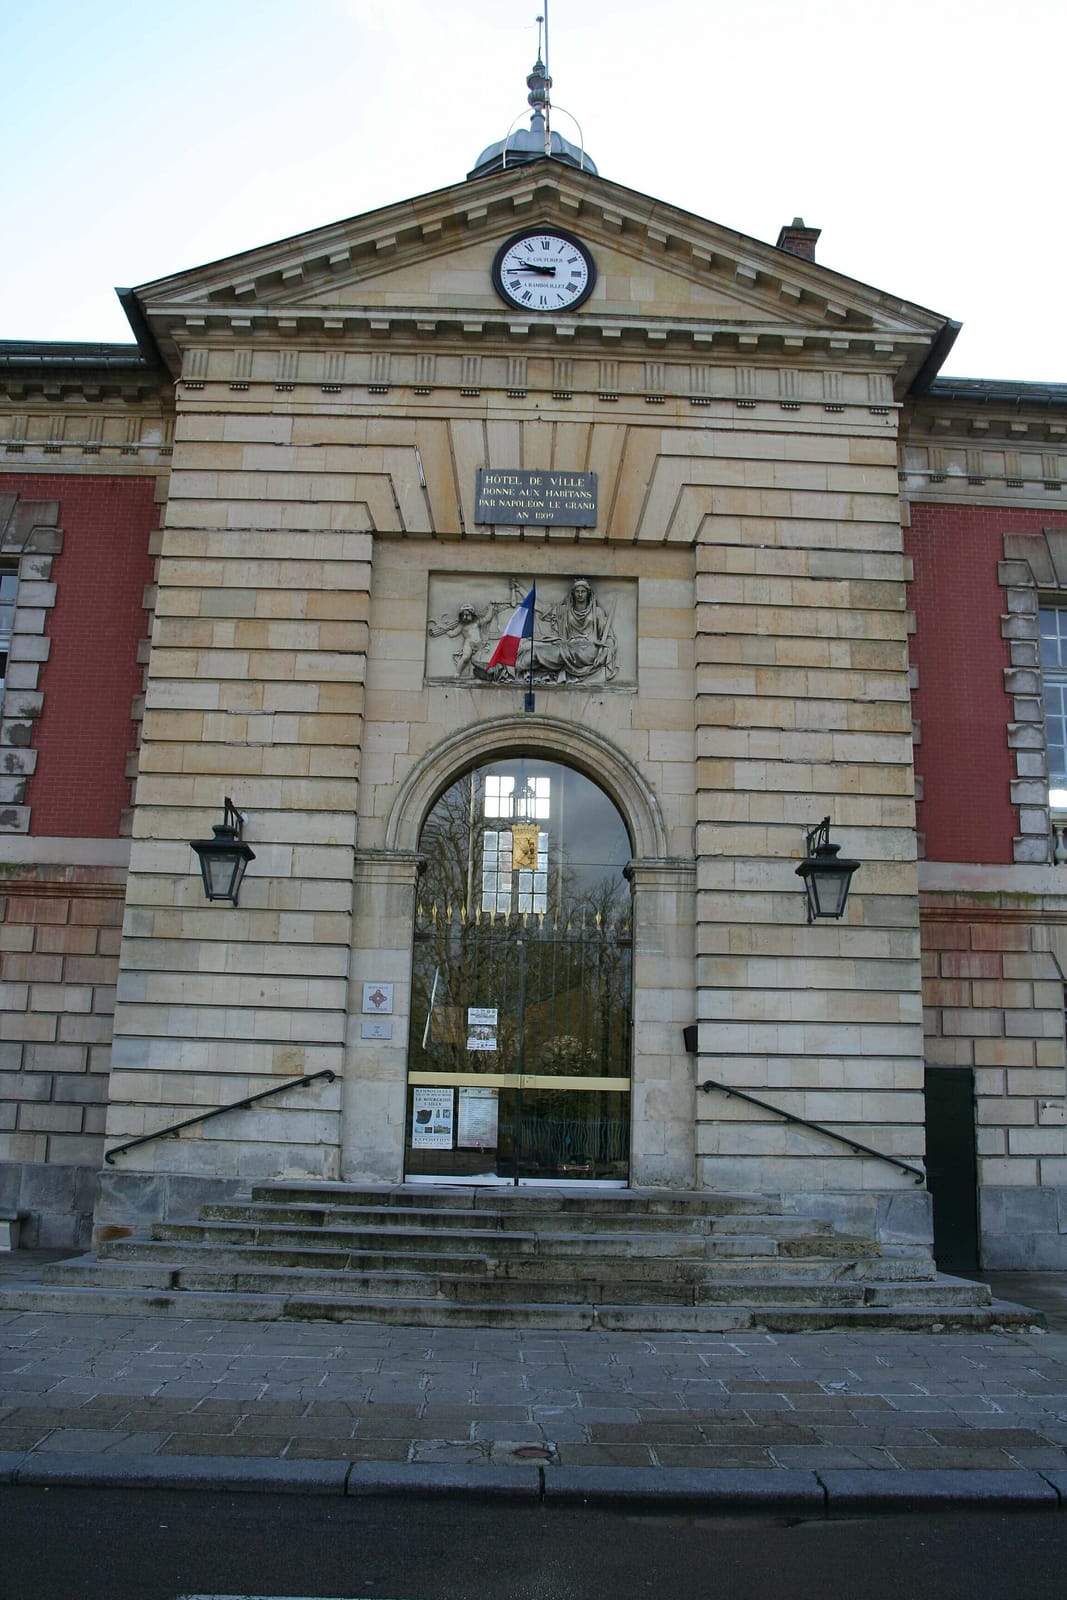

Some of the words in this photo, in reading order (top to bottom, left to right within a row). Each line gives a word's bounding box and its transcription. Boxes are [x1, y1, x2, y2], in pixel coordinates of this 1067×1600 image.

[529, 476, 543, 486] DE
[550, 475, 585, 487] VILLE
[519, 488, 540, 497] AUX
[479, 498, 496, 507] PAR
[549, 501, 561, 509] LE
[565, 502, 595, 510] GRAND
[516, 511, 529, 520] AN
[535, 511, 554, 520] 1809
